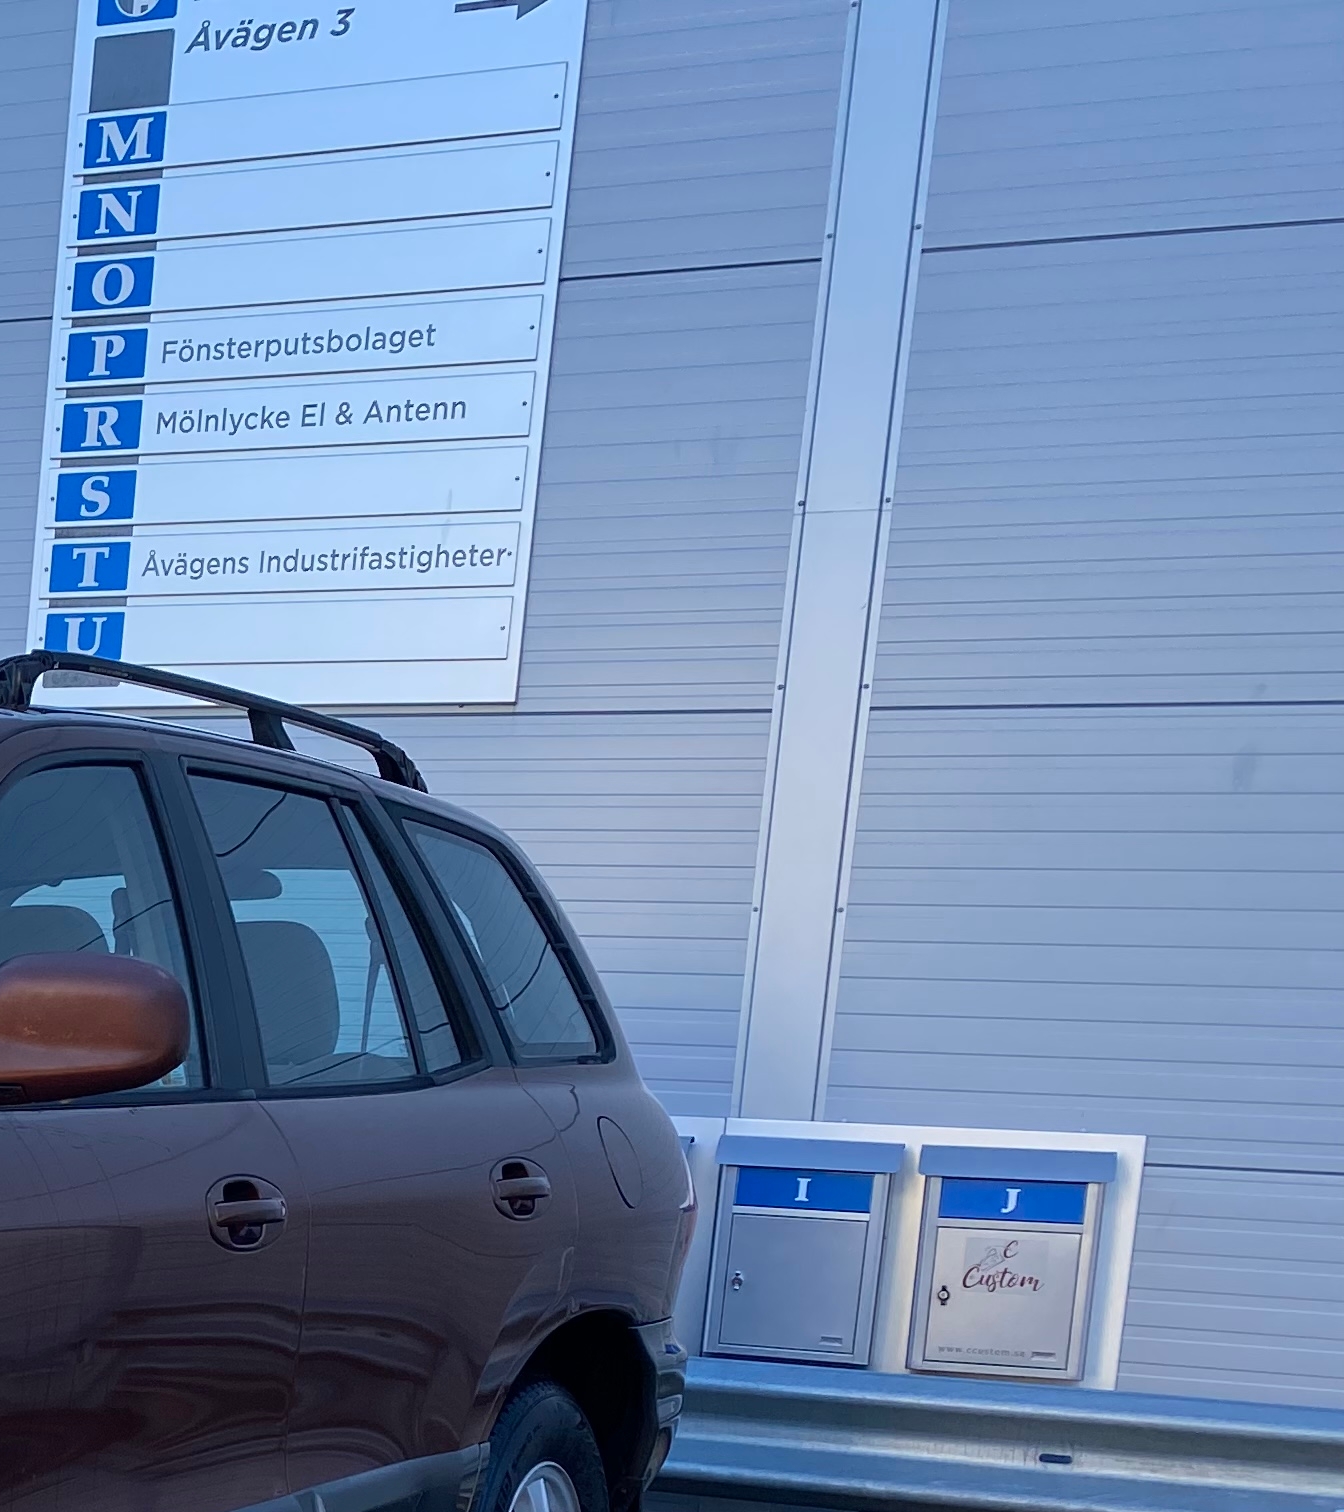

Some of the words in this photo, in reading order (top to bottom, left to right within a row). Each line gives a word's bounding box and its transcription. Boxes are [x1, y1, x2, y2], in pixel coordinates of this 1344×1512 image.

[184, 18, 319, 54] Åvägen
[330, 8, 356, 37] 3
[96, 117, 155, 163] M
[94, 190, 143, 235] N
[91, 263, 135, 305] O
[87, 334, 126, 378] P
[161, 323, 436, 364] Fönsterputsbolaget
[80, 406, 121, 448] R
[155, 405, 290, 436] Mölnlycke
[335, 401, 354, 426] &
[364, 398, 467, 425] Antenn
[80, 475, 111, 518] S
[72, 546, 110, 588] T
[142, 549, 250, 582] Åvägens
[259, 544, 508, 575] Industrifastigheter
[64, 616, 108, 656] U
[795, 1177, 812, 1202] I
[1000, 1188, 1022, 1214] J
[1003, 1240, 1019, 1258] C
[962, 1266, 1045, 1292] Custom
